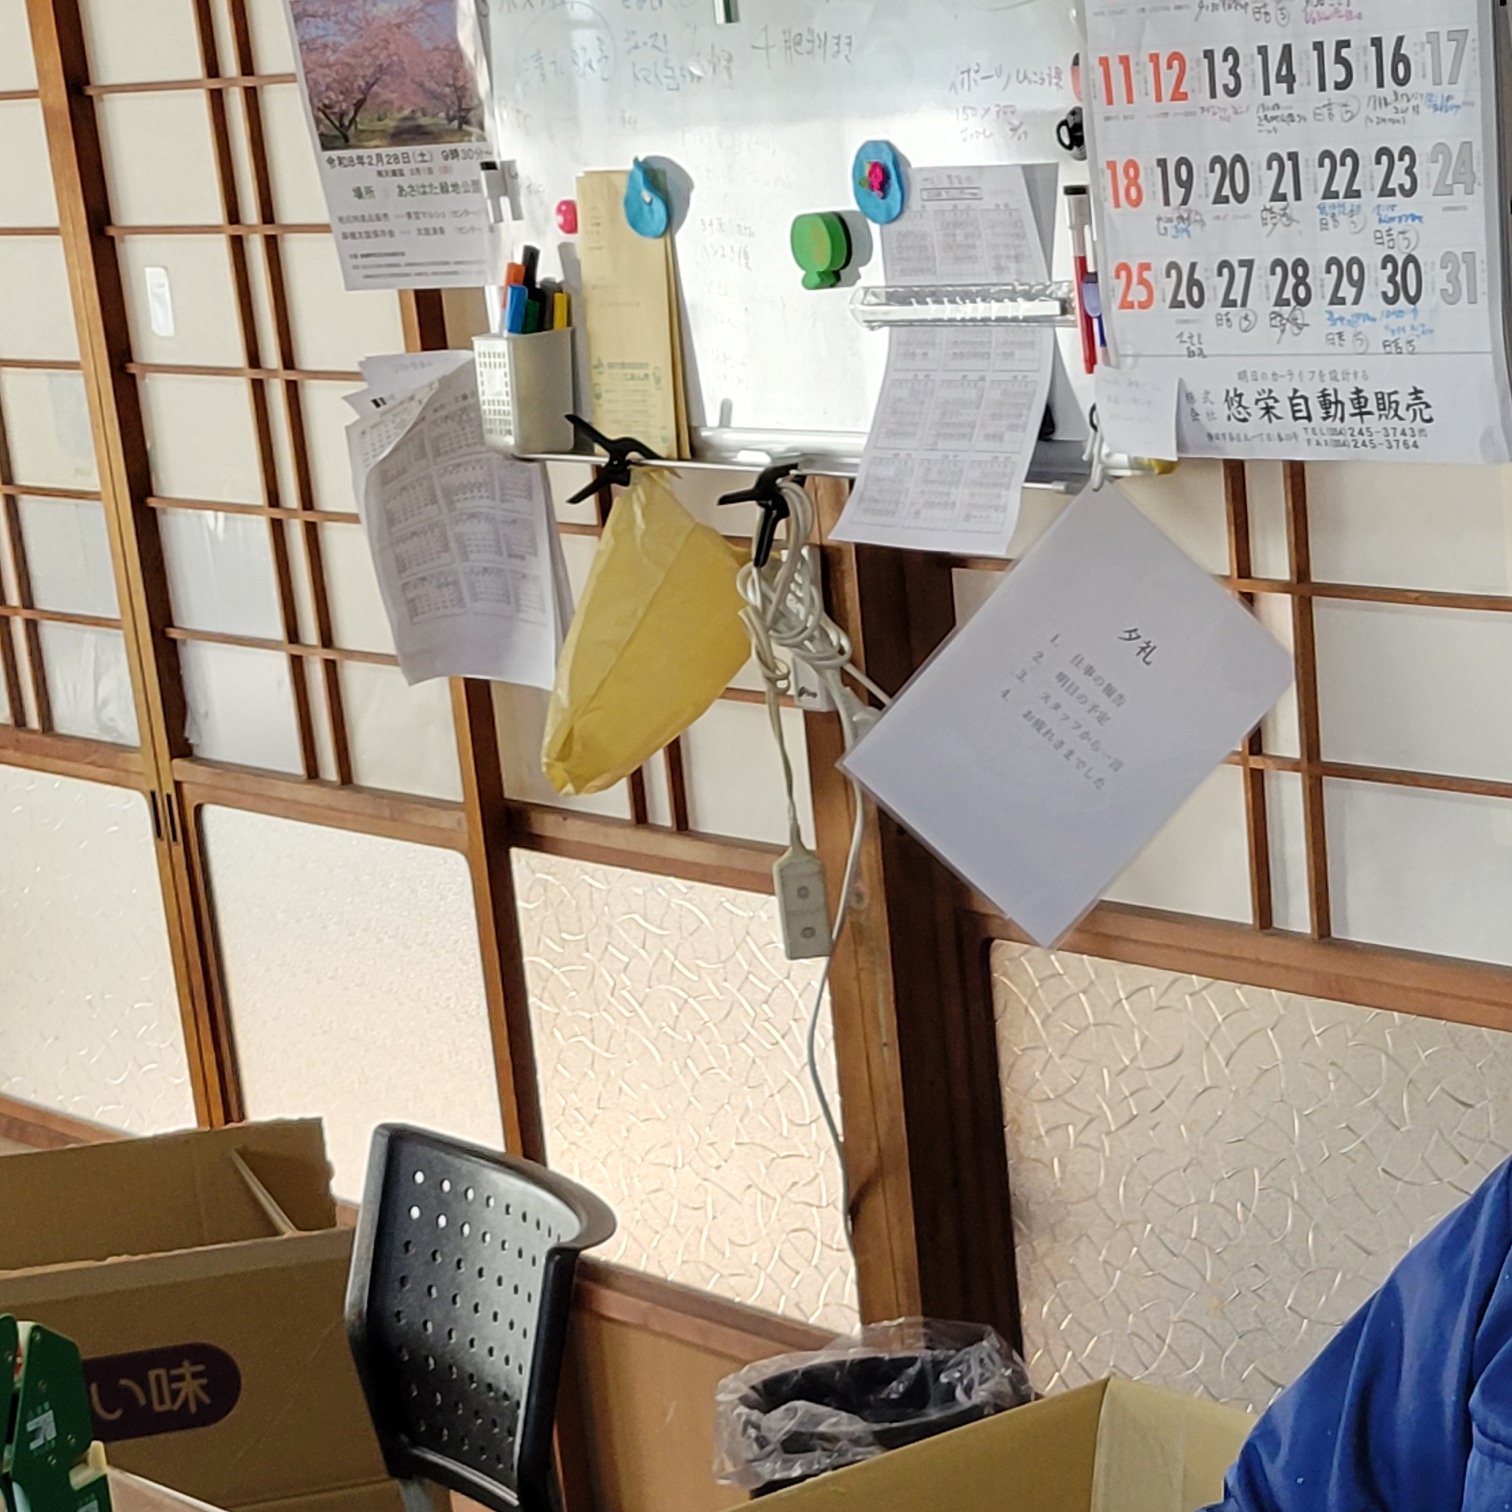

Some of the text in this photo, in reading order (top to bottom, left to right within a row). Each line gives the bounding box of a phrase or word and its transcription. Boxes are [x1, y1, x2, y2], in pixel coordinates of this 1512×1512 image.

[1098, 29, 1469, 106] 11 12 13 14 15 16 17
[1106, 142, 1476, 208] 18 19 20 21 22 23 24
[1115, 251, 1478, 310] 25 26 27 28 29 30 31
[1224, 386, 1434, 424] 悠栄自動車販売
[1055, 671, 1112, 727] 明日の予定
[1069, 652, 1127, 708] 仕事の報告
[1022, 708, 1105, 790] お疲れさまでした
[1037, 691, 1125, 773] スタッフから一言
[91, 1360, 210, 1421] い味
